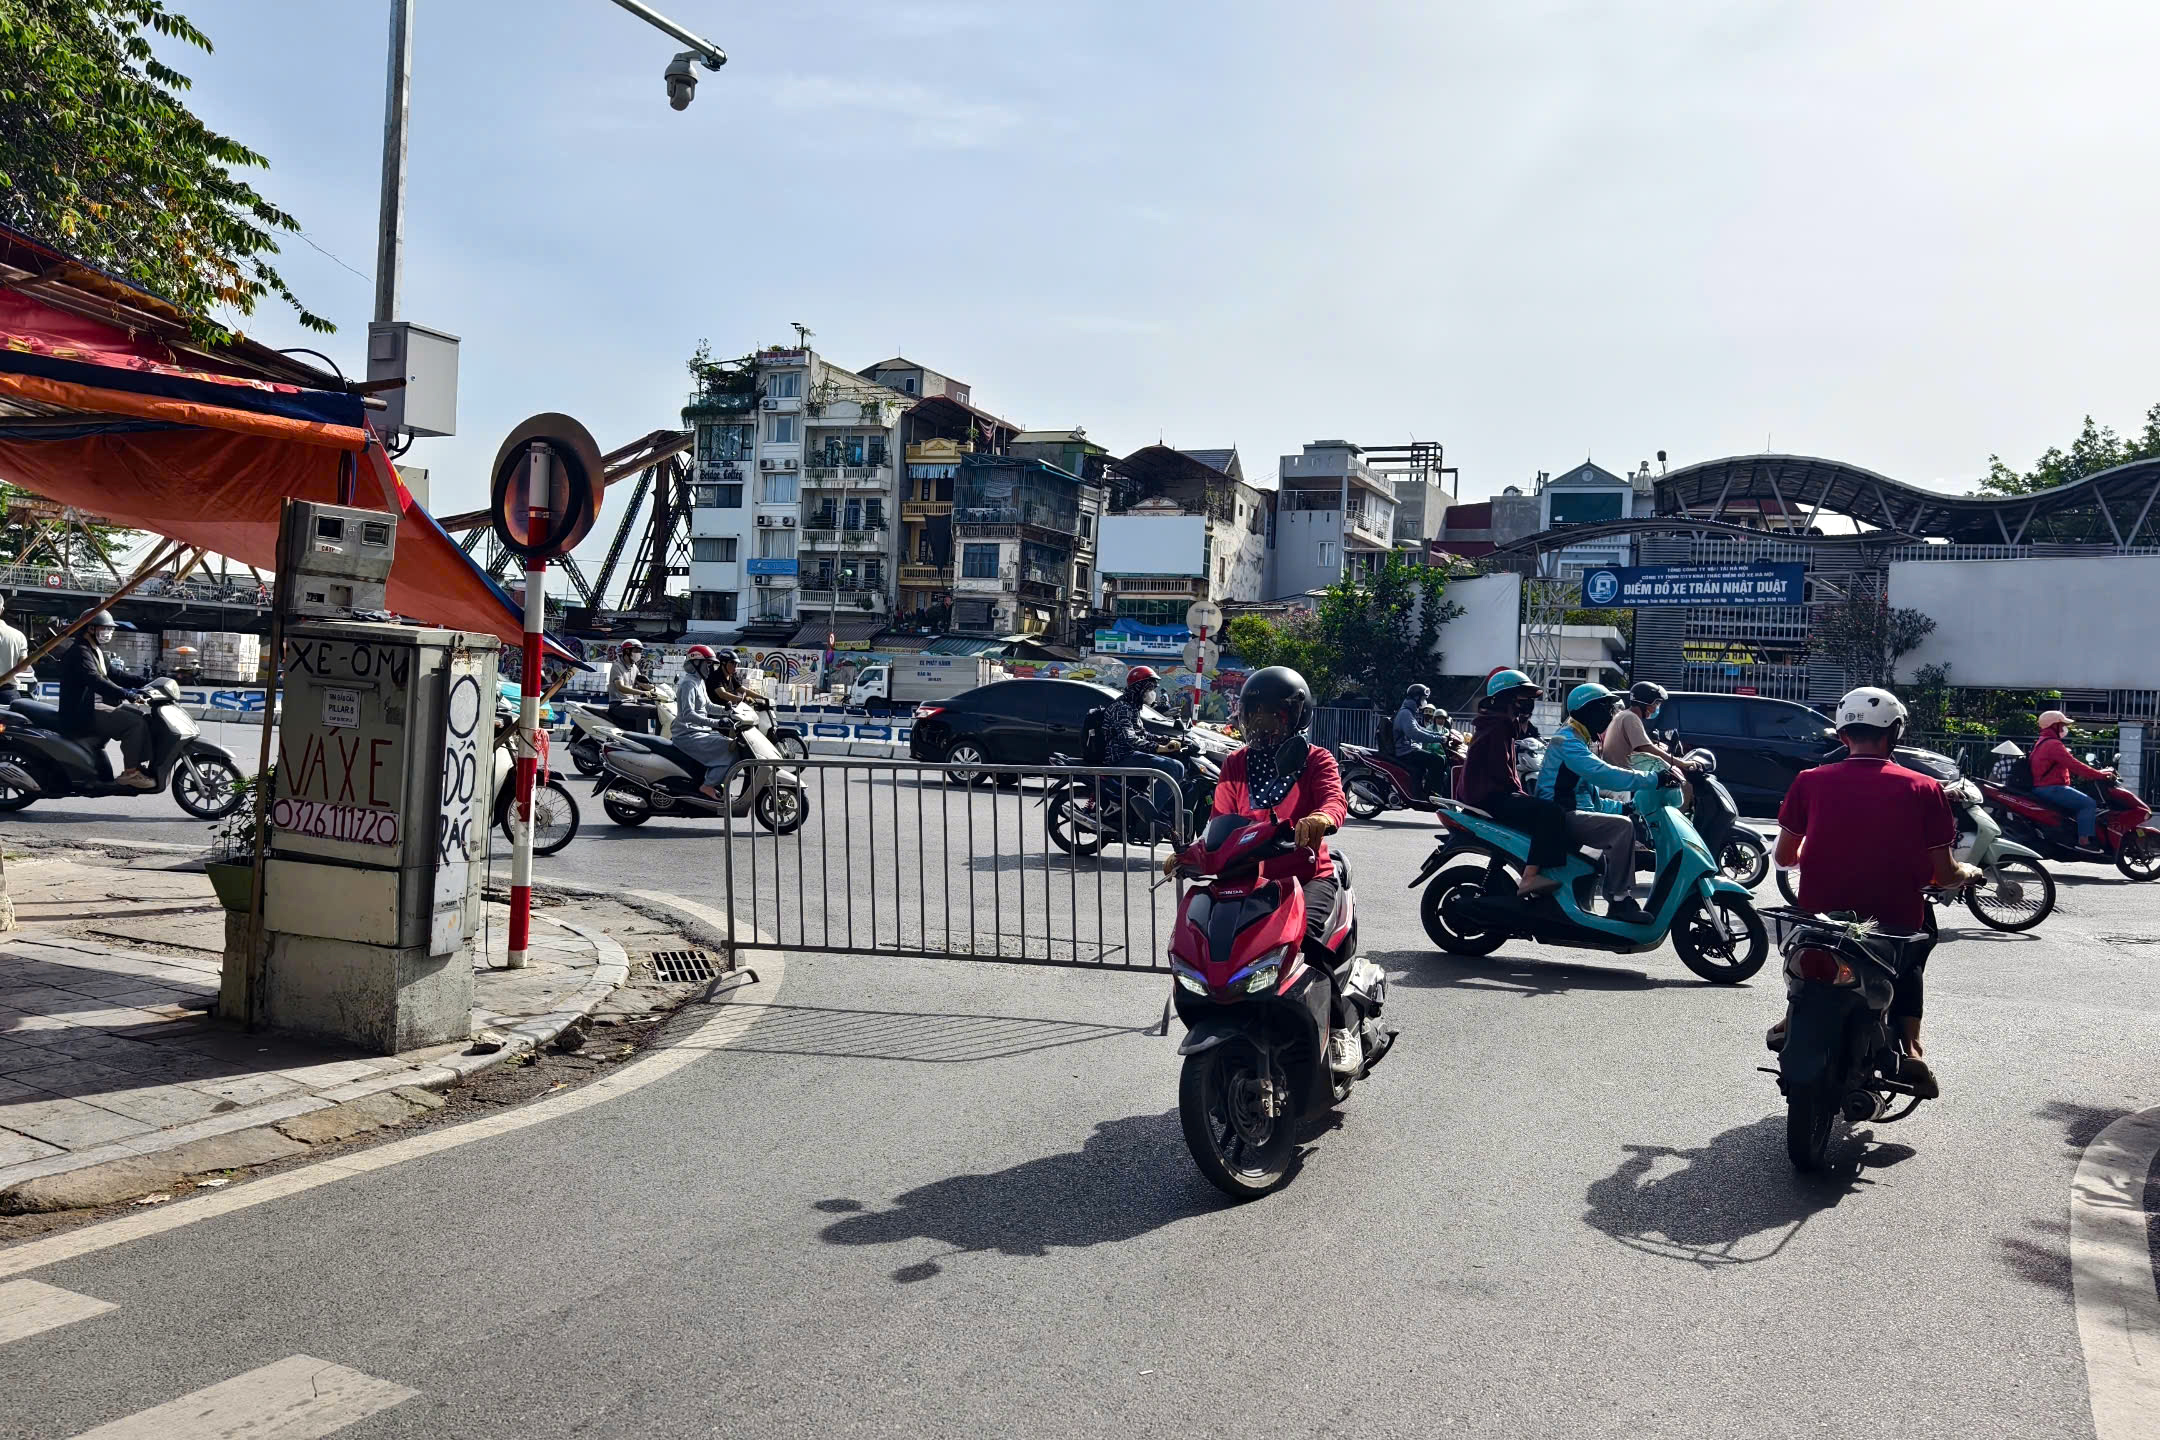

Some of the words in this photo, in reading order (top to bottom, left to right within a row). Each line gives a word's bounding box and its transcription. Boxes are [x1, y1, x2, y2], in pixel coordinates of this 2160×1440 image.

[1623, 580, 1651, 595] ĐIỂM
[1654, 579, 1670, 595] ĐỖ
[1672, 583, 1687, 595] XE
[1689, 579, 1720, 594] TRẦN
[1722, 579, 1754, 595] NHẬT
[1756, 579, 1788, 595] DUẬT
[280, 727, 340, 800] VÁ
[338, 736, 393, 807] XE
[273, 799, 397, 846] 0326111720
